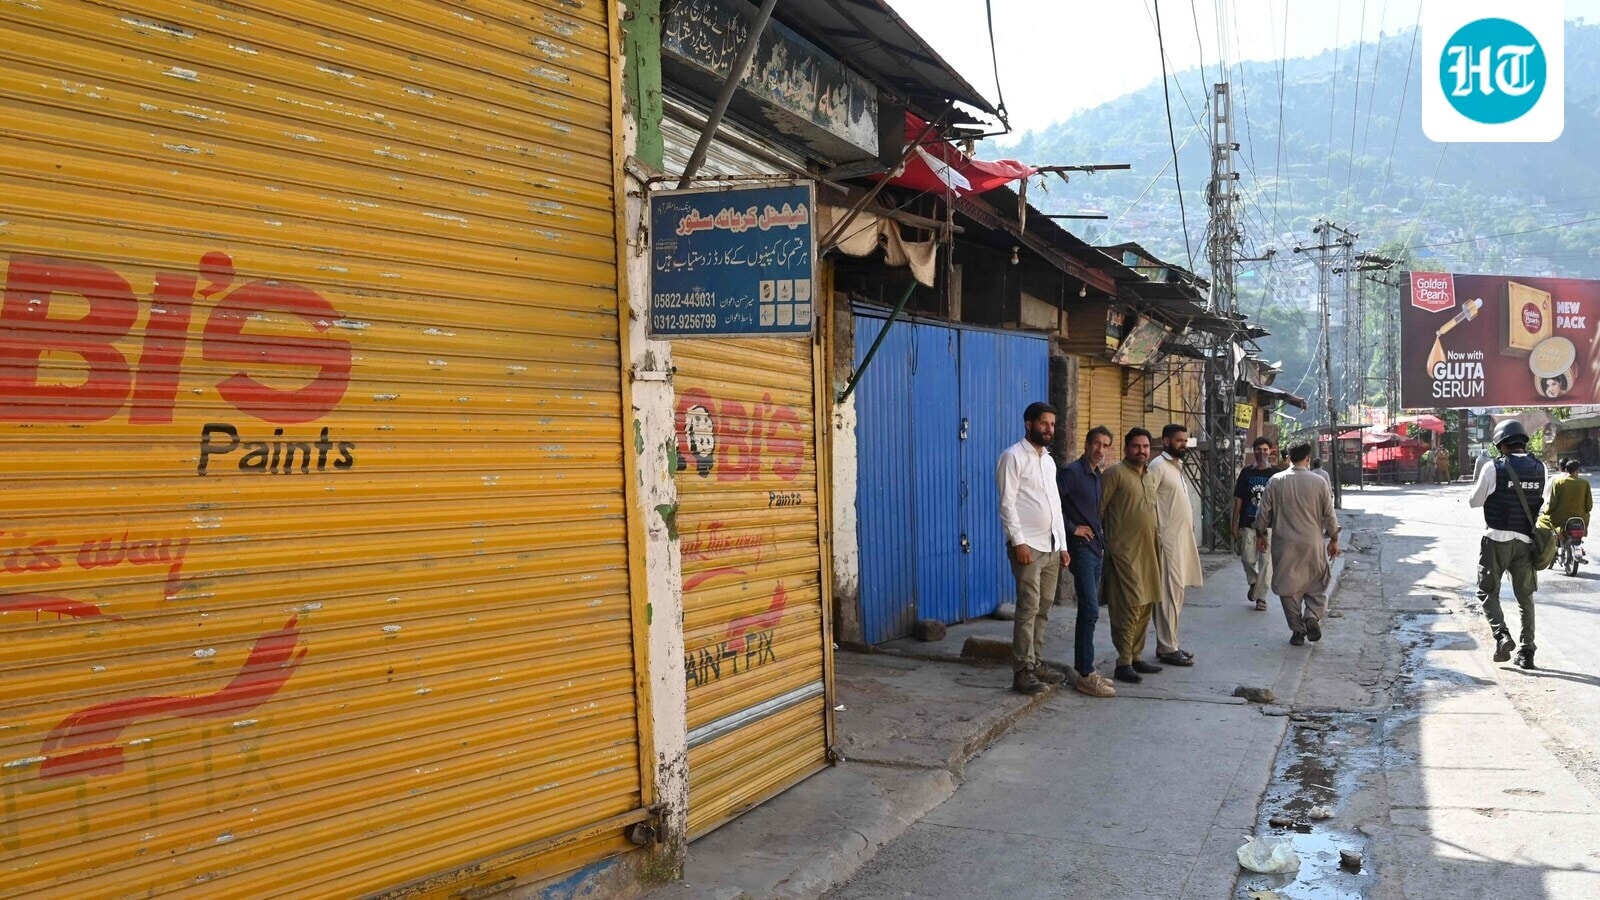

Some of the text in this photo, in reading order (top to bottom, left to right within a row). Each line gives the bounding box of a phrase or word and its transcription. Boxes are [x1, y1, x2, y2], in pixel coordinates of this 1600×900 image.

[676, 203, 808, 236] نیشنل کریانہ سٹور
[731, 245, 746, 265] کے
[777, 240, 790, 266] کی
[787, 238, 803, 270] قسم
[797, 251, 807, 266] ہر
[657, 254, 672, 272] ہیں
[1417, 278, 1447, 289] Golden
[654, 292, 715, 308] 05822-443031
[1417, 288, 1449, 301] Pearl
[1556, 301, 1581, 314] NEW
[654, 314, 716, 329] 0312-9256799
[1556, 316, 1586, 329] PACK
[1447, 351, 1484, 360] Now with
[1433, 362, 1485, 380] GLUTA
[1432, 380, 1484, 398] SERUM
[197, 423, 356, 477] Paints
[768, 491, 802, 507] Paints
